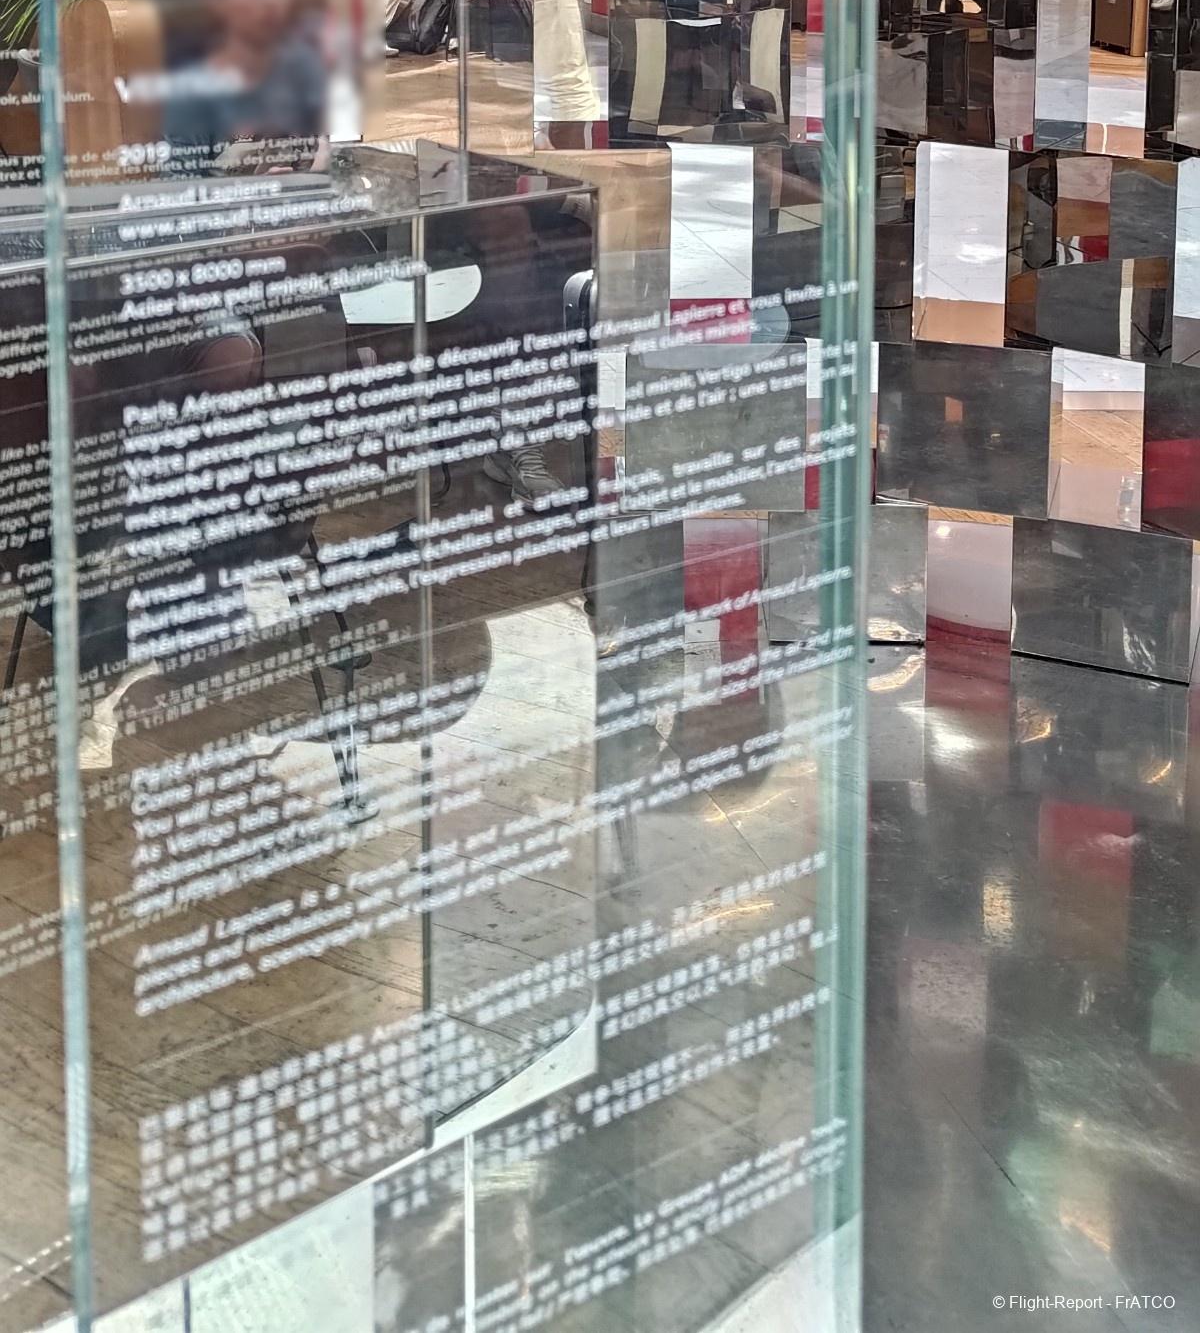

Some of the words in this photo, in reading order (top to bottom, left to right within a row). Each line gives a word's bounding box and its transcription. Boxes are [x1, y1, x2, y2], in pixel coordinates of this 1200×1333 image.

[117, 140, 171, 167] 2019
[119, 185, 196, 213] Arnaud
[198, 179, 283, 205] Lapierre
[118, 296, 176, 322] Acier
[176, 290, 223, 313] inox
[223, 279, 264, 313] poli
[119, 267, 174, 296] 3500
[175, 269, 191, 287] x
[244, 256, 287, 278] mm
[73, 328, 129, 349] échelles
[130, 324, 144, 338] et
[123, 400, 177, 426] Paris
[181, 380, 276, 415] Aéroport
[277, 376, 327, 397] vous
[328, 360, 407, 393] propose
[409, 353, 434, 372] de
[437, 336, 520, 367] découvrir
[589, 310, 659, 339] d'Arnaud
[664, 302, 726, 327] Lapierre
[728, 294, 746, 313] et
[748, 292, 783, 310] vous
[785, 282, 825, 303] invite
[124, 424, 200, 452] voyage
[269, 399, 334, 424] entrez
[334, 391, 357, 412] et
[357, 373, 464, 408] contemplez
[464, 367, 493, 386] les
[494, 354, 549, 380] reflets
[551, 349, 568, 368] et
[627, 336, 658, 354] des
[659, 327, 702, 348] cubes
[124, 452, 185, 477] Votre
[186, 431, 295, 470] perception
[297, 424, 324, 443] de
[325, 402, 417, 438] l'aéroport
[418, 399, 458, 419] sera
[459, 386, 500, 411] ainsi
[501, 374, 579, 402] modifiée.
[126, 468, 215, 504] Absorbé
[216, 464, 251, 490] par
[254, 458, 276, 477] la
[278, 442, 356, 471] hauteur
[357, 436, 384, 455] de
[556, 396, 586, 419] par
[696, 360, 751, 384] Vertigo
[753, 352, 788, 371] vous
[125, 494, 241, 530] métaphore
[244, 481, 301, 505] d'une
[386, 437, 498, 475] l'abstraction
[499, 430, 525, 449] du
[653, 395, 673, 415] et
[674, 393, 696, 410] de
[738, 380, 768, 397] une
[125, 528, 201, 556] voyage
[127, 574, 206, 608] Arnaud
[317, 532, 399, 564] designer
[409, 505, 493, 541] industriel
[504, 498, 524, 517] et
[534, 485, 588, 510] artiste
[672, 451, 734, 478] travaille
[741, 445, 767, 461] sur
[774, 437, 800, 453] des
[808, 421, 857, 450] projets
[421, 532, 494, 561] échelles
[495, 523, 513, 543] et
[669, 481, 687, 500] et
[688, 479, 703, 496] le
[127, 625, 231, 662] intérieure
[408, 552, 511, 590] l'expression
[512, 532, 589, 567] plastique
[591, 522, 608, 541] et
[609, 516, 650, 537] leurs
[699, 596, 733, 619] work
[131, 787, 192, 815] Come
[195, 778, 216, 797] in
[217, 763, 256, 789] and
[131, 817, 173, 840] You
[175, 800, 210, 826] will
[210, 794, 249, 816] see
[250, 783, 282, 804] the
[131, 845, 161, 865] As
[166, 823, 235, 854] Vertigo
[134, 926, 209, 965] Arnaud
[215, 901, 295, 937] Lapierre
[685, 745, 738, 772] creates
